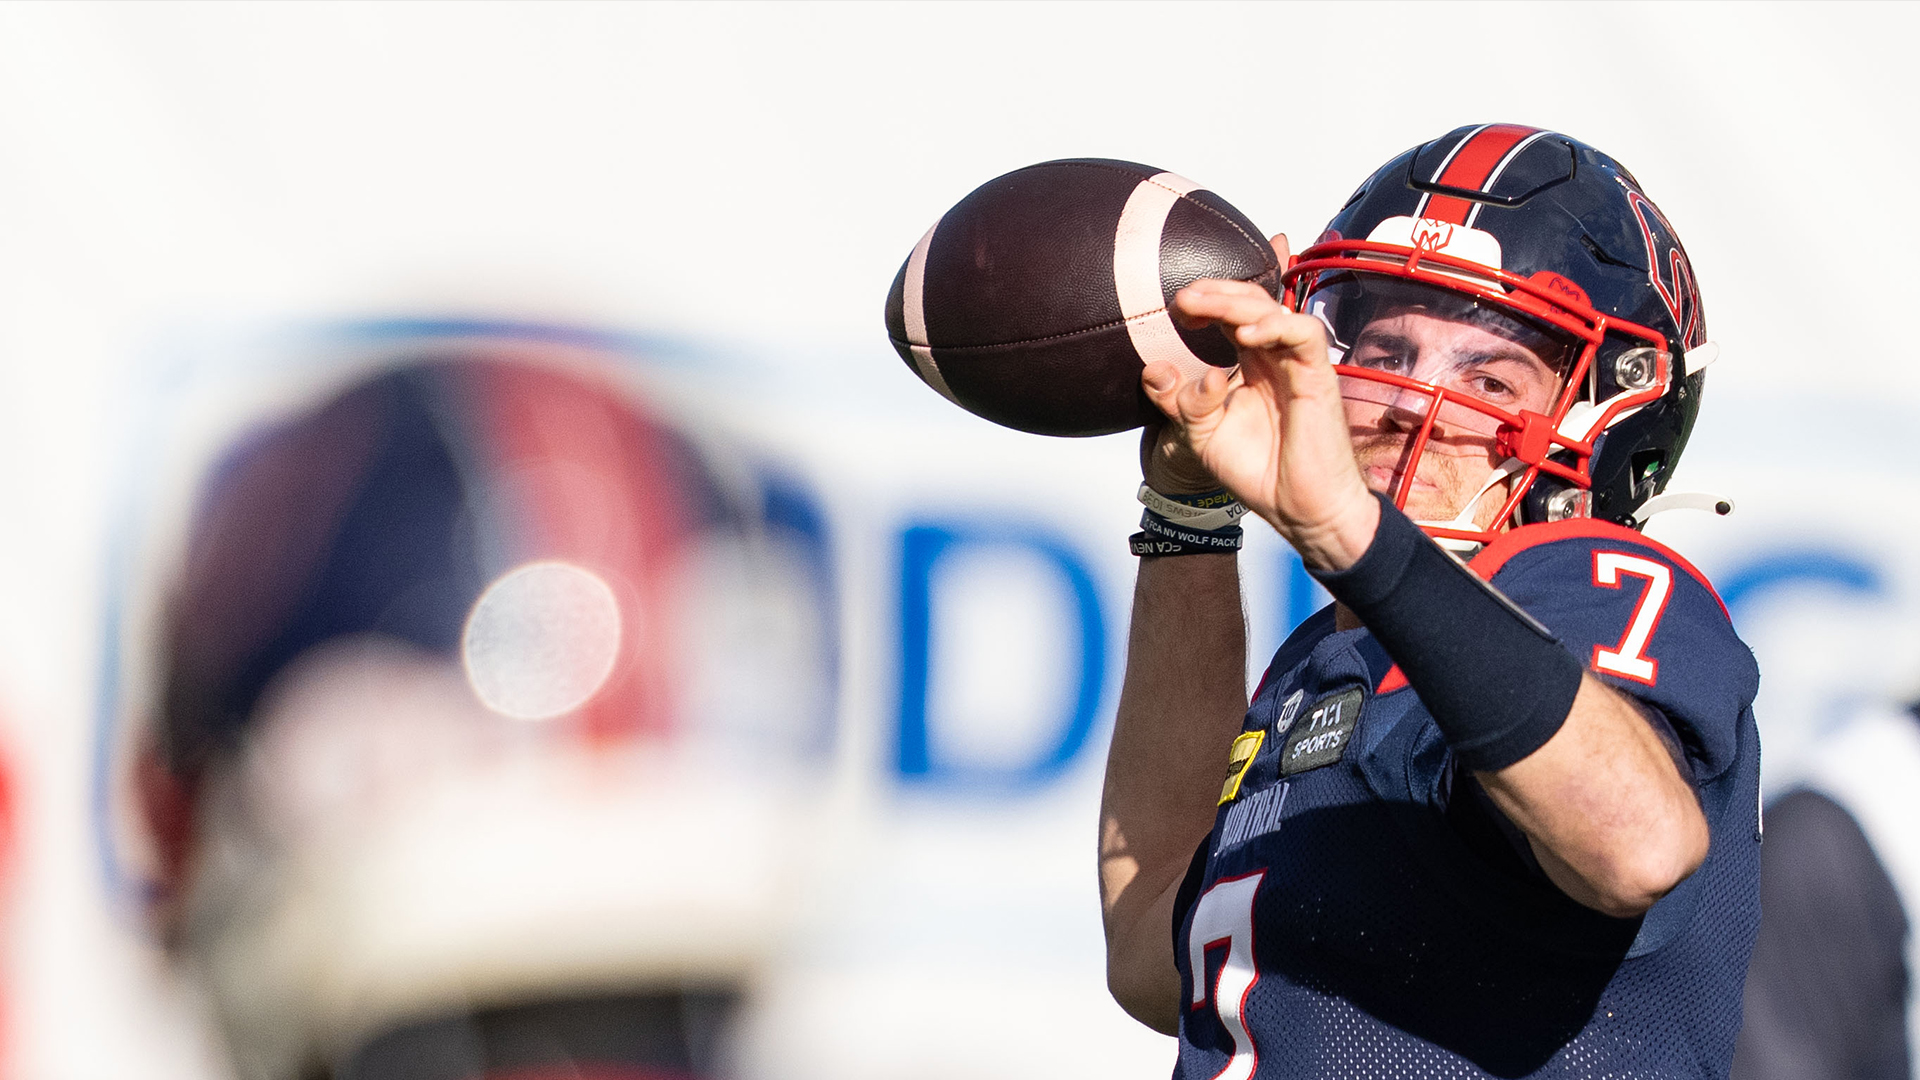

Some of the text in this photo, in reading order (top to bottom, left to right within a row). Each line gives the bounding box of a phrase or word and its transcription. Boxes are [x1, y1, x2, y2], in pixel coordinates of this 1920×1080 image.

[1149, 520, 1237, 548] FCA NV WOLF PACK
[1592, 549, 1675, 687] 7
[1292, 729, 1344, 760] SPORTS
[1189, 867, 1268, 1080] 7
